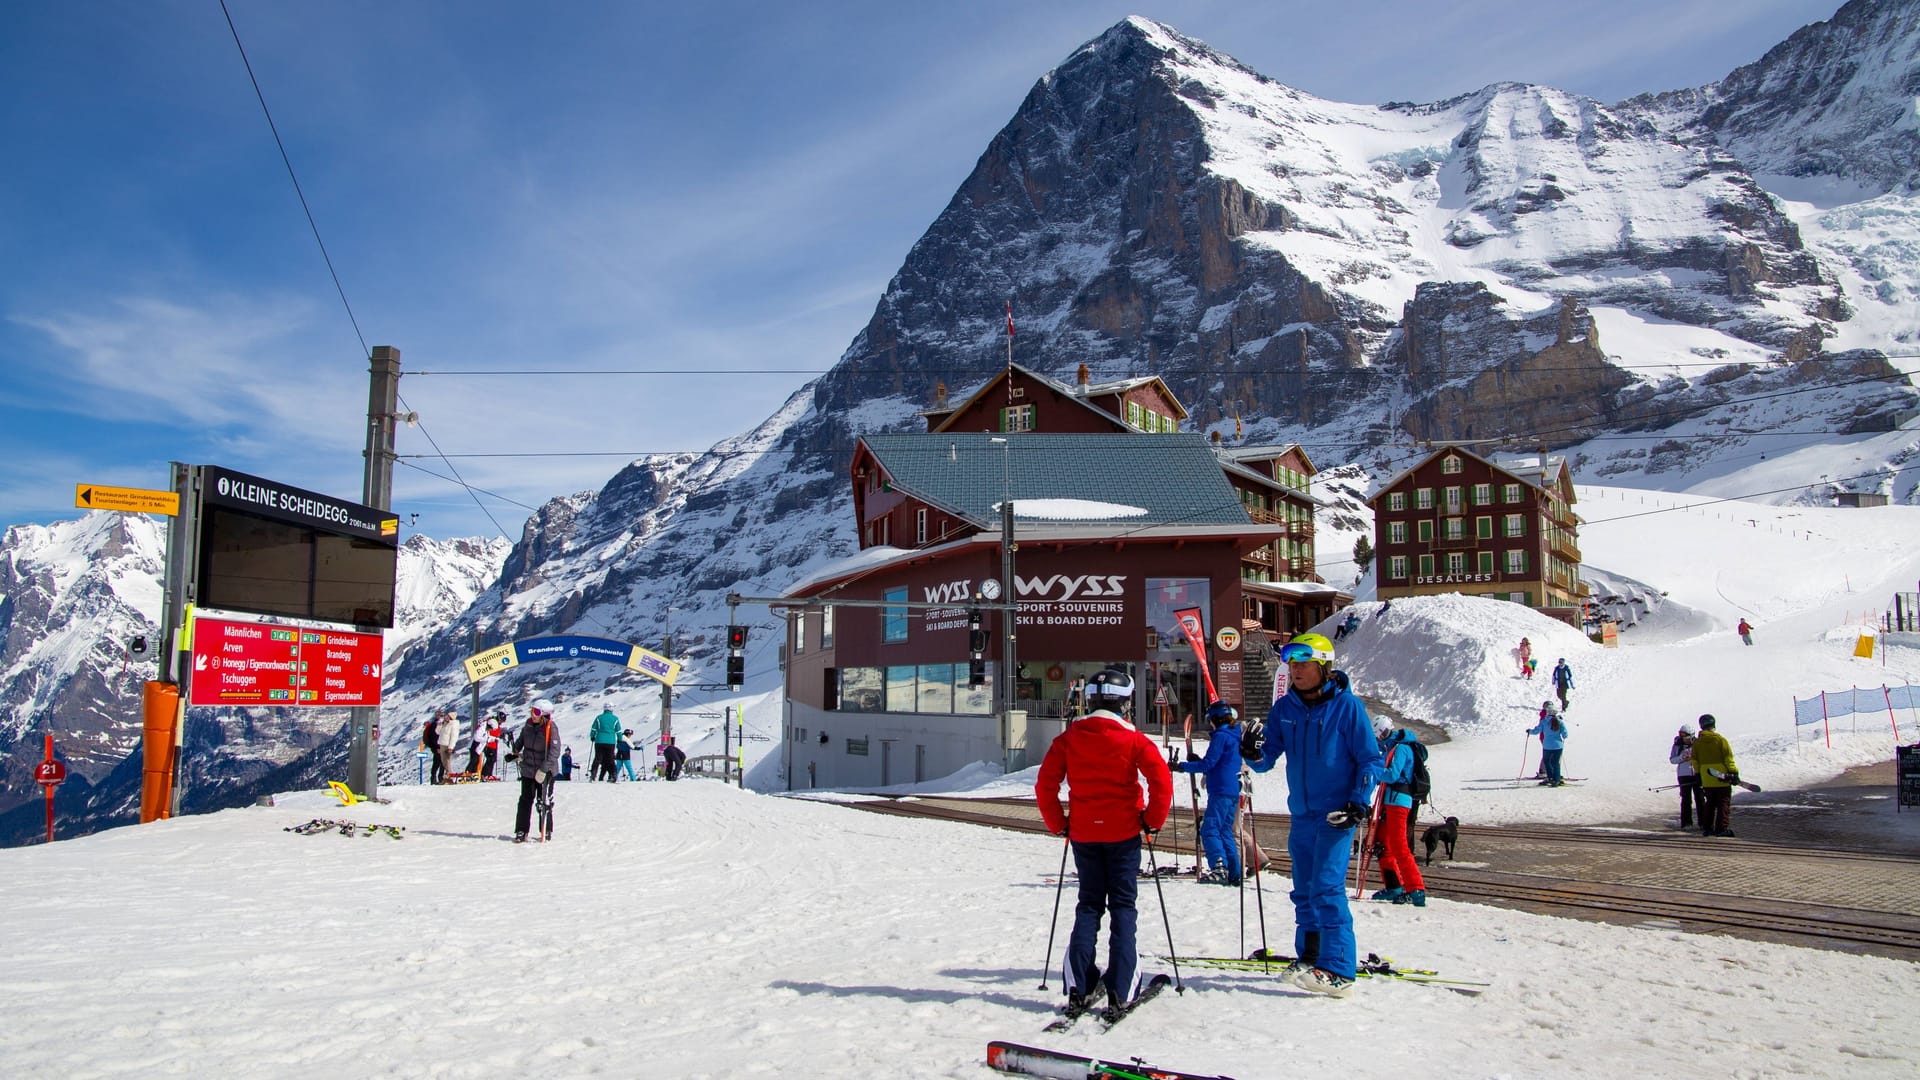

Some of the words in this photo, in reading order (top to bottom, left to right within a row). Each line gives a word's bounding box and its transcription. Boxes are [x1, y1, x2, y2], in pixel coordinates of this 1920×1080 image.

[94, 490, 128, 499] Restaurant
[231, 480, 278, 508] KLEINE
[280, 493, 348, 524] SCHEIDEGG
[938, 620, 954, 630] BOARD
[1016, 616, 1034, 624] SKI
[1037, 616, 1044, 624] &
[1048, 616, 1086, 624] BOARD
[1088, 616, 1122, 624] DEPOT
[224, 626, 262, 638] Männlichen
[328, 636, 358, 646] Grindelwald
[223, 642, 243, 652] Arven
[528, 646, 564, 654] Brandegg
[581, 645, 624, 656] Grindelwald
[326, 649, 352, 662] Brandegg
[472, 648, 510, 667] Beginners
[222, 658, 246, 670] Honegg
[326, 664, 342, 672] Arven
[476, 664, 494, 676] Park
[222, 673, 256, 686] Tschuggen
[326, 678, 346, 688] Honegg
[42, 764, 56, 774] 21
